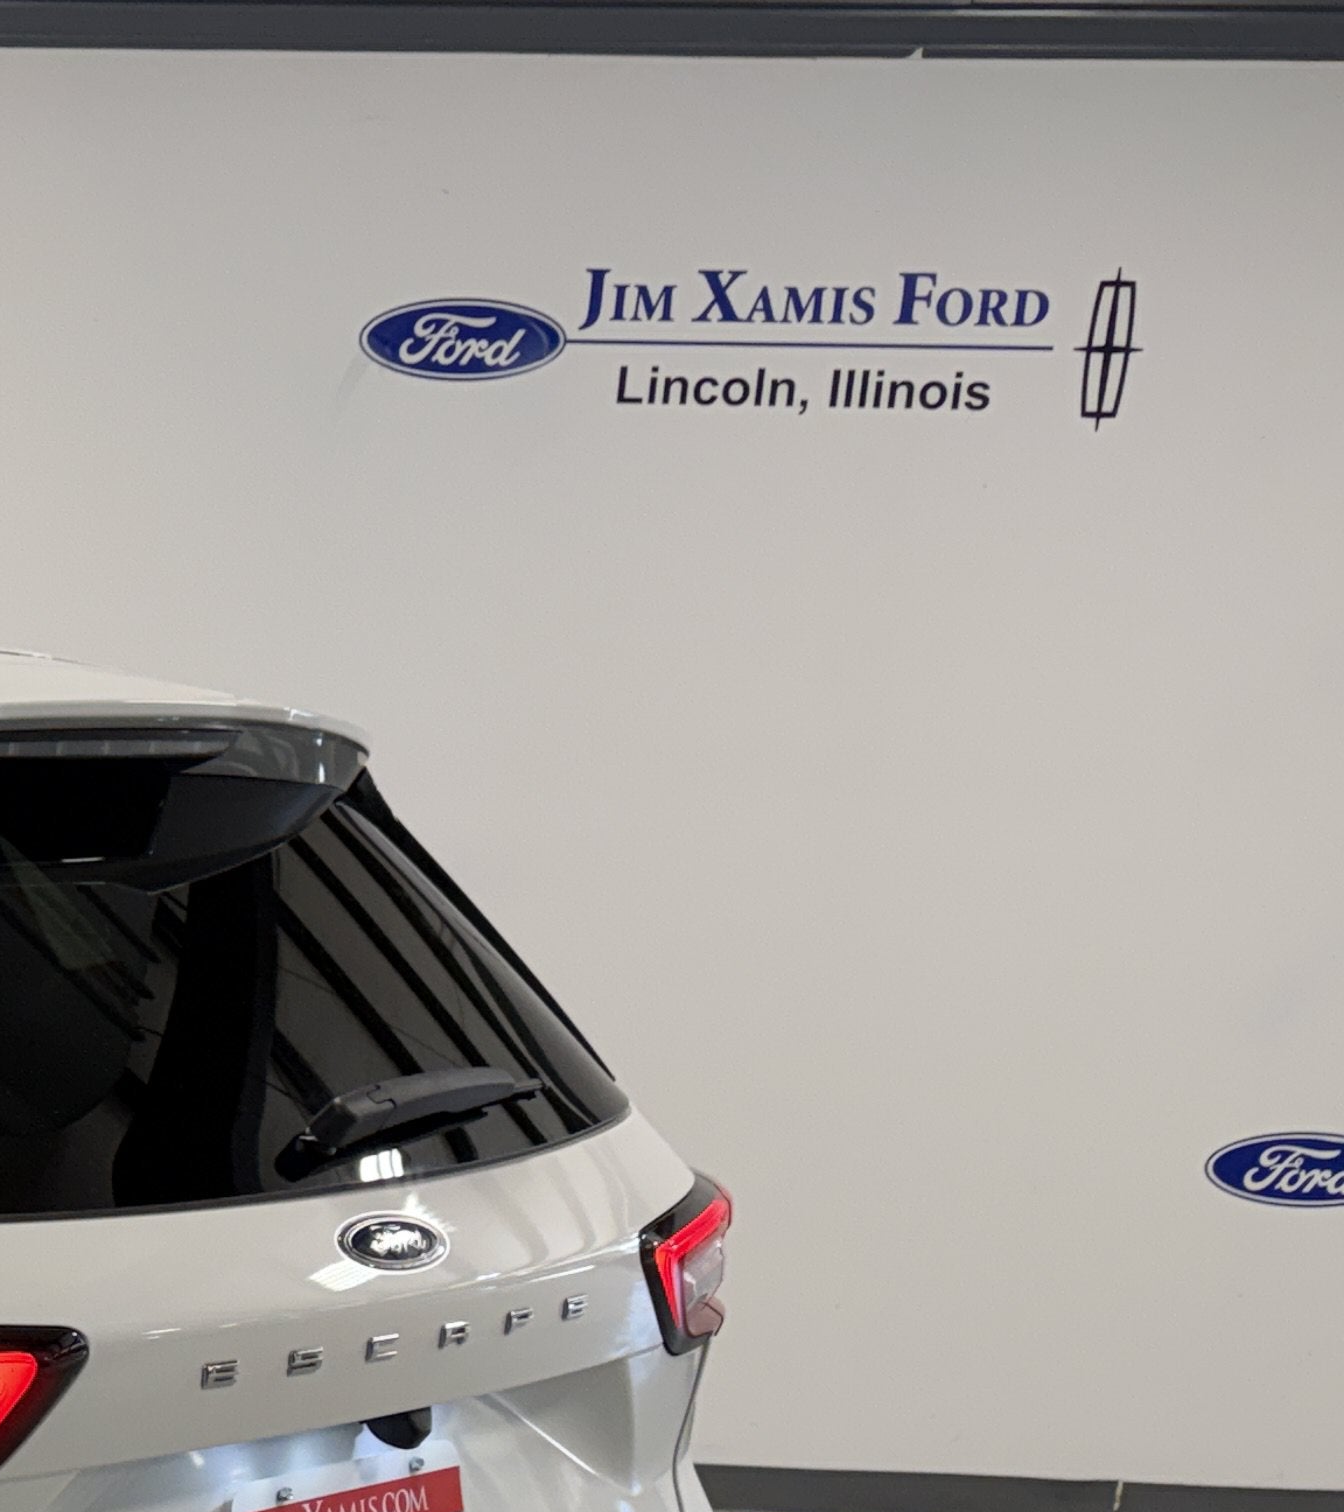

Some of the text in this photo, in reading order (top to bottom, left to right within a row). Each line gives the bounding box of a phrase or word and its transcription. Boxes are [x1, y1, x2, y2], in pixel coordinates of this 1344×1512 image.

[578, 268, 1050, 331] JIM XAMIS FORD
[399, 311, 521, 368] Ford
[616, 365, 991, 415] Lincoln, Illinois
[201, 1294, 588, 1390] ESCAPE
